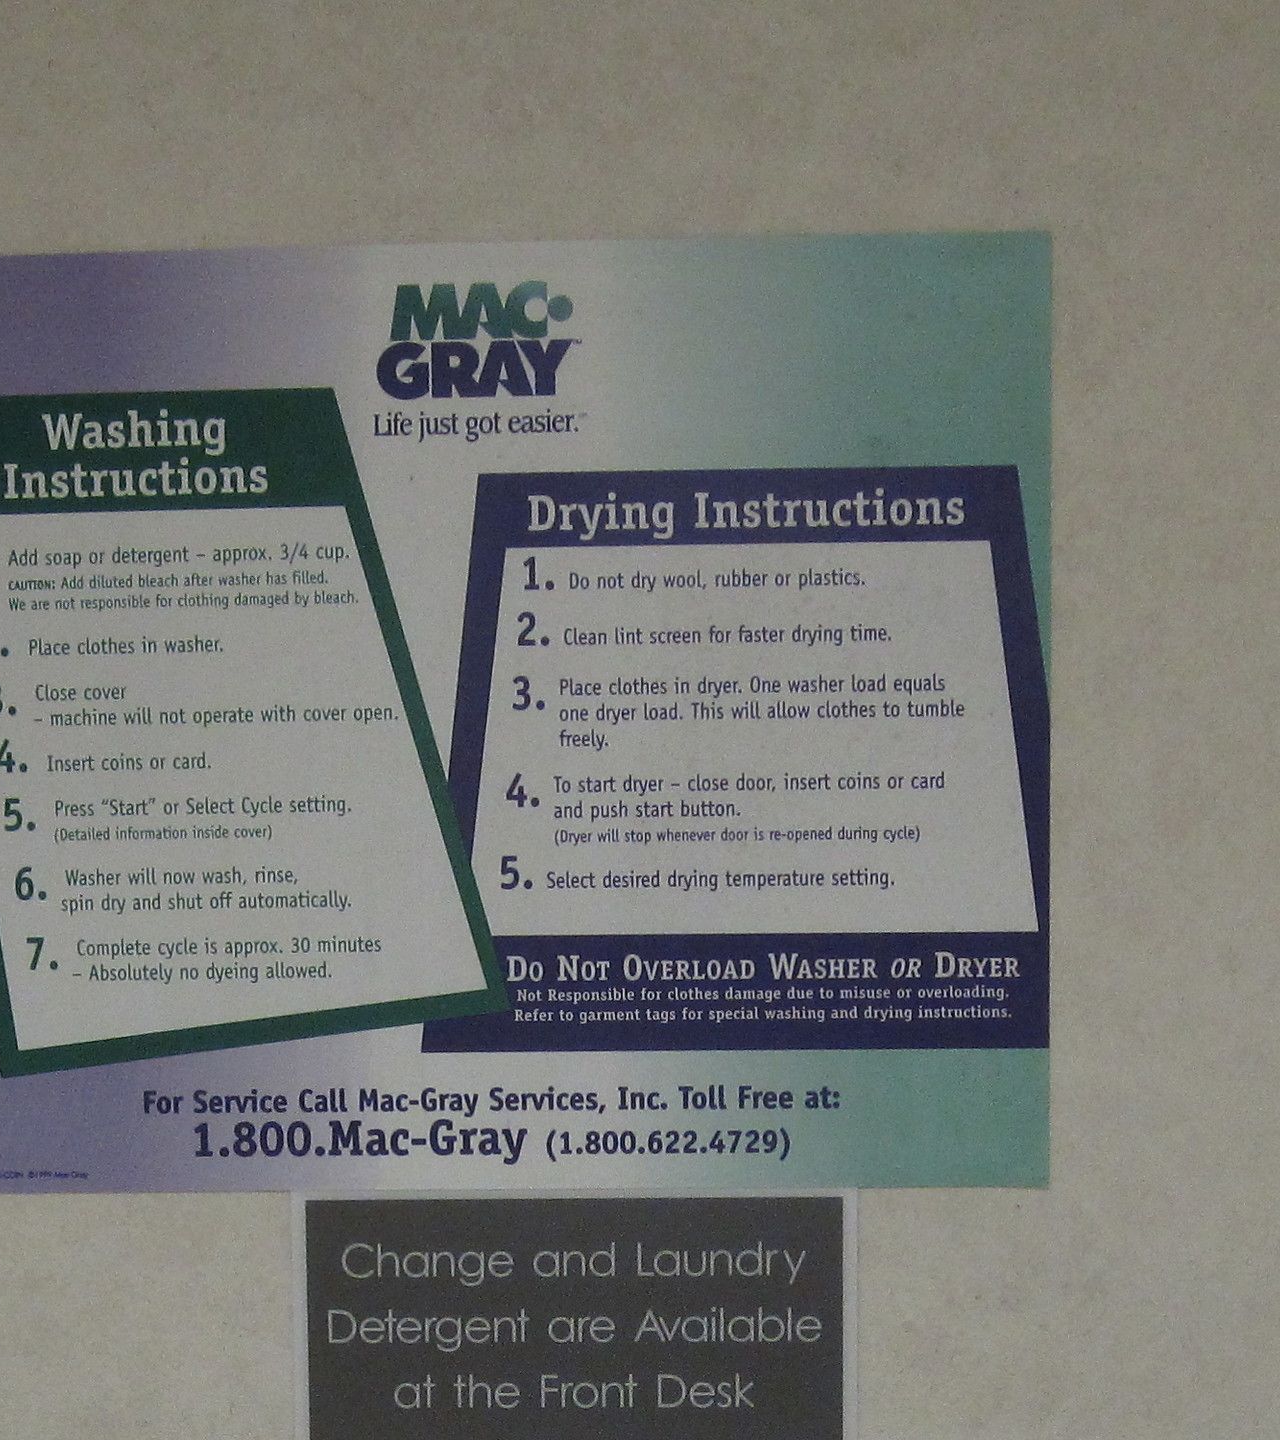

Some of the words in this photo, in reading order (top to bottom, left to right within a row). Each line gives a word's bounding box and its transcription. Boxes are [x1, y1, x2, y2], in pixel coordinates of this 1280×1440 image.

[376, 338, 573, 401] GRAY
[41, 408, 226, 460] Washing
[373, 411, 413, 437] Life
[418, 411, 459, 443] just
[465, 411, 502, 443] got
[507, 408, 579, 434] easier.
[3, 456, 269, 499] Instructions
[527, 491, 675, 541] Drying
[694, 487, 965, 529] Instructions
[7, 547, 39, 567] Add
[44, 551, 83, 570] soap
[88, 551, 105, 565] or
[111, 545, 190, 568] detergent
[212, 546, 272, 566] approx.
[280, 542, 309, 565] 3/4
[315, 540, 352, 564] cup.
[7, 579, 56, 592] CAUTION:
[60, 575, 85, 590] Add
[88, 573, 134, 590] diluted
[137, 573, 179, 589] bleach
[183, 572, 214, 587] after
[218, 571, 261, 587] washer
[265, 570, 288, 586] has
[291, 569, 329, 585] filled.
[523, 556, 555, 591] 1.
[568, 571, 590, 591] Do
[596, 572, 625, 590] not
[630, 570, 657, 594] dry
[662, 569, 707, 590] wool,
[714, 567, 769, 588] rubber
[774, 572, 791, 587] or
[798, 567, 866, 591] plastics.
[517, 611, 550, 647] 2.
[563, 627, 608, 647] Clean
[614, 626, 643, 646] lint
[649, 630, 702, 645] screen
[708, 624, 732, 644] for
[737, 624, 785, 644] faster
[791, 623, 844, 648] drying
[849, 623, 892, 643] time.
[47, 754, 95, 773] Insert
[101, 752, 144, 772] coins
[149, 756, 166, 770] or
[172, 751, 212, 770] card.
[3, 797, 36, 832] 5.
[54, 799, 95, 818] Press
[162, 801, 180, 816] or
[185, 796, 236, 815] Select
[241, 795, 283, 819] Cycle
[289, 794, 352, 817] setting.
[500, 855, 533, 890] 5.
[546, 870, 597, 890] Select
[602, 869, 661, 889] desired
[667, 868, 719, 893] drying
[725, 869, 825, 891] temperature
[831, 867, 895, 891] setting.
[514, 1008, 554, 1022] Refer
[558, 1009, 574, 1022] to
[579, 1008, 641, 1025] garment
[645, 1008, 676, 1024] tags
[681, 1006, 703, 1021] for
[708, 1006, 759, 1024] special
[764, 1005, 826, 1023] washing
[830, 1005, 858, 1019] and
[863, 1005, 913, 1023] drying
[917, 1004, 1012, 1019] instructions.
[143, 1090, 183, 1114] For
[193, 1088, 288, 1114] Service
[298, 1087, 348, 1113] Call
[359, 1087, 479, 1118] Mac-Gray
[488, 1085, 606, 1115] Services,
[617, 1085, 668, 1111] Inc.
[678, 1084, 727, 1110] Toll
[738, 1085, 794, 1110] Free
[804, 1086, 840, 1109] at:
[194, 1118, 528, 1166] 1.800.Mac-Gray
[545, 1127, 791, 1163] (1.800.622.4729)
[340, 1242, 515, 1287] Change
[532, 1241, 616, 1278] and
[636, 1240, 807, 1285] Laundry
[327, 1308, 530, 1353] Detergent
[547, 1315, 616, 1344] are
[634, 1306, 823, 1343] Available
[393, 1374, 436, 1410] at
[453, 1373, 521, 1410] the
[540, 1373, 638, 1409] Front
[657, 1372, 755, 1409] Desk
